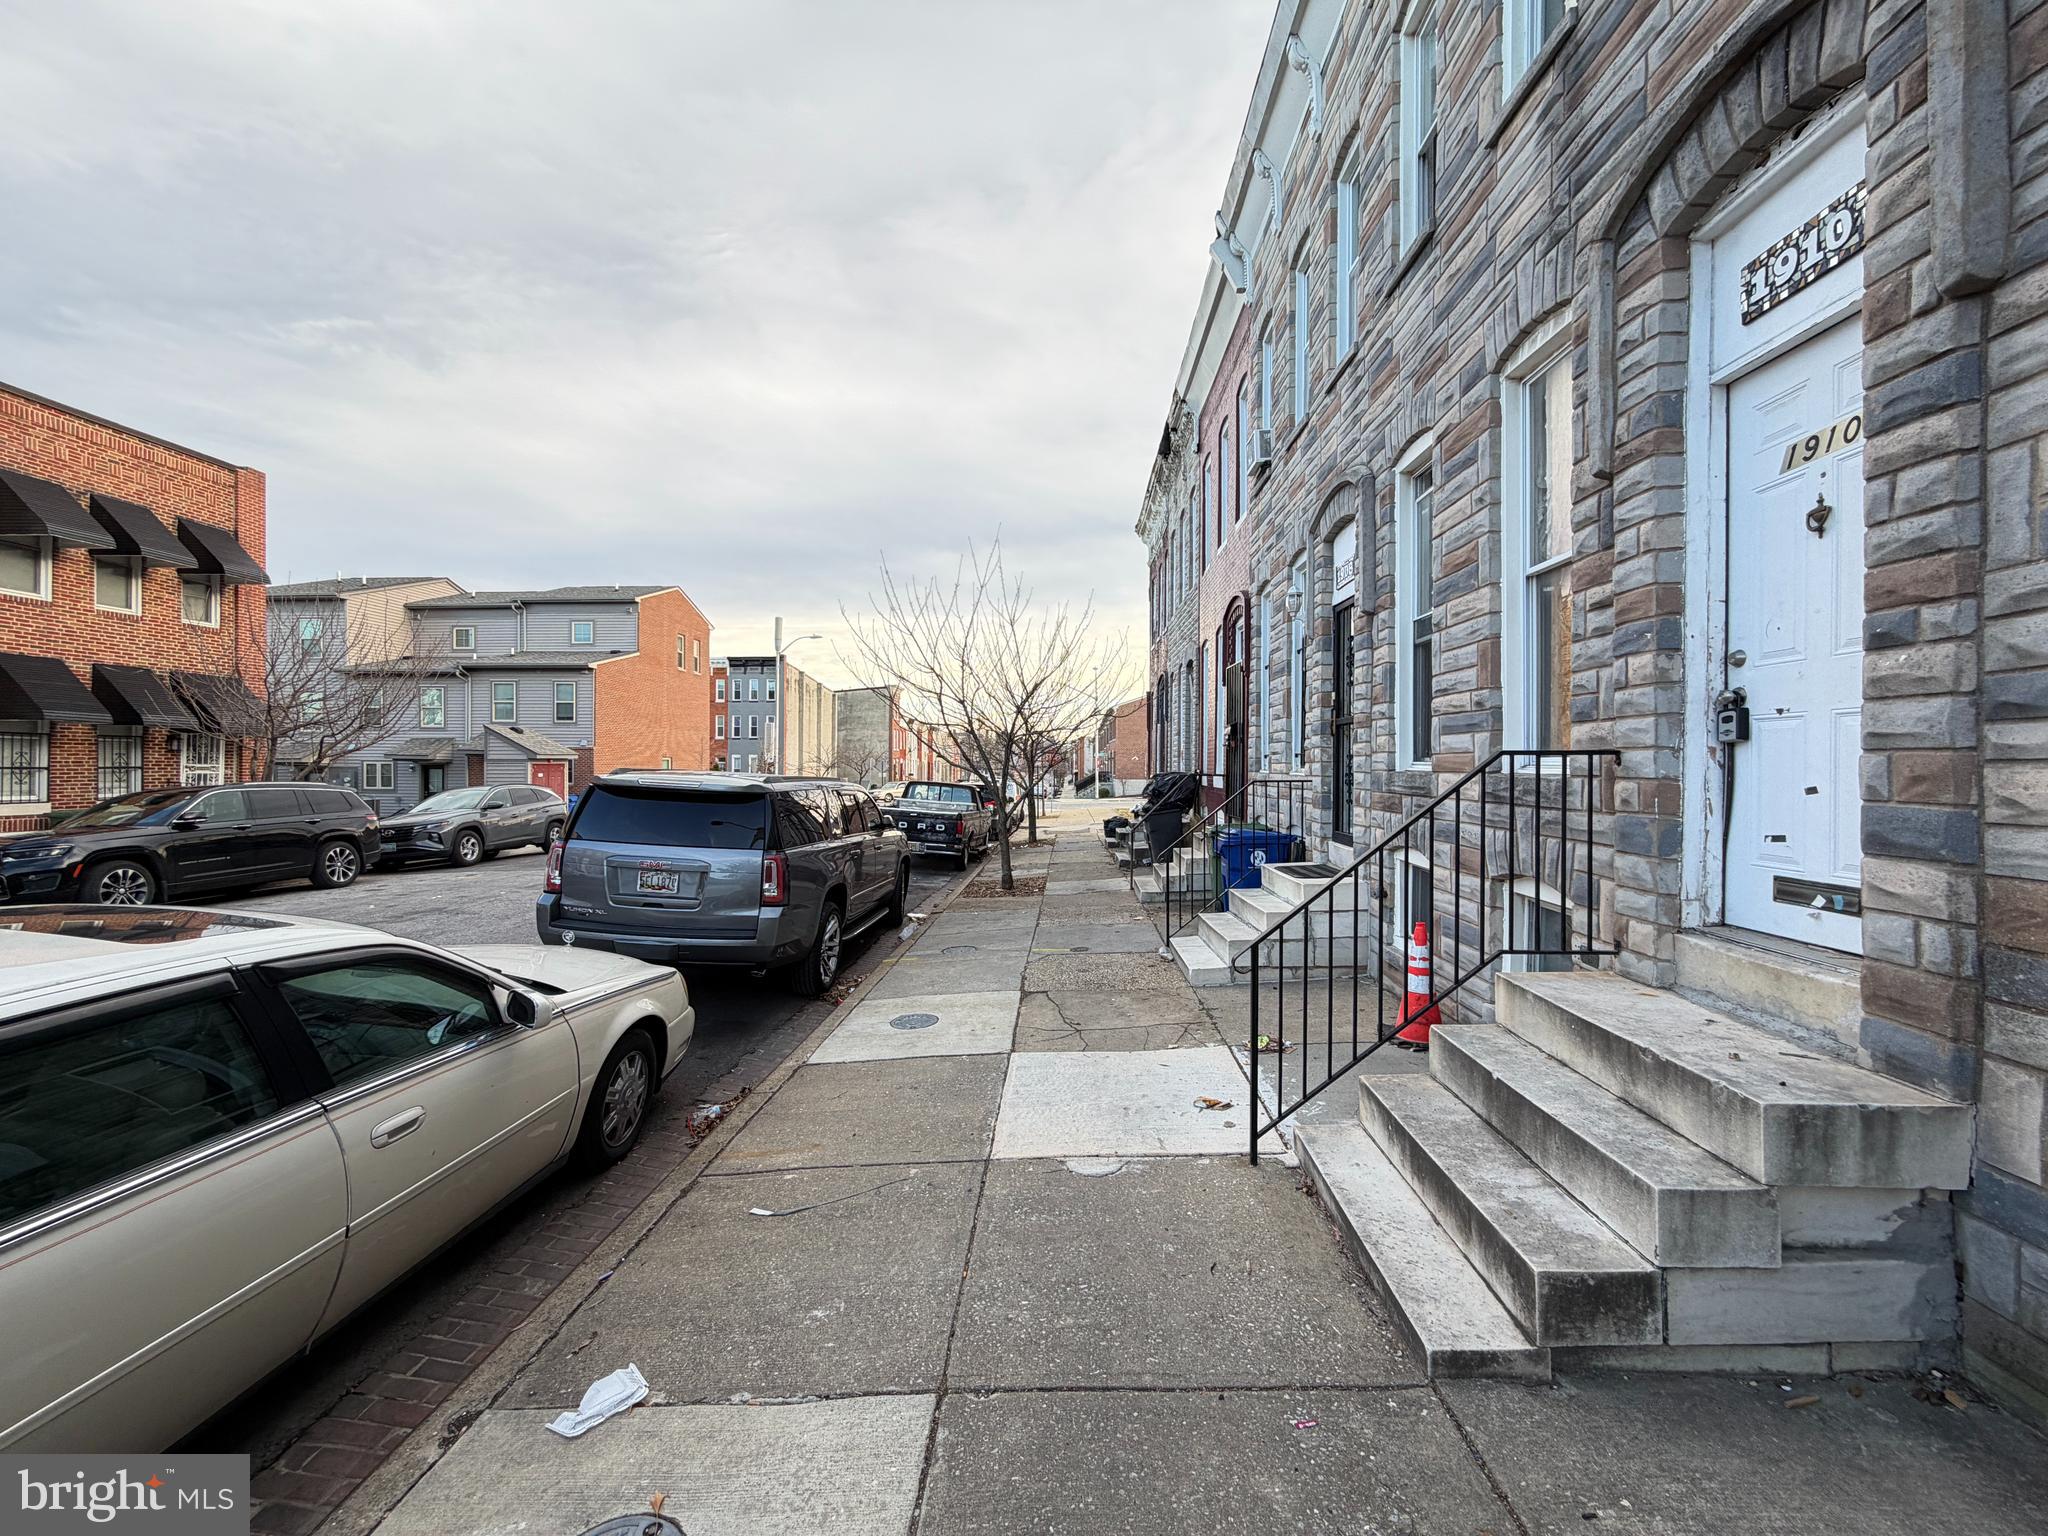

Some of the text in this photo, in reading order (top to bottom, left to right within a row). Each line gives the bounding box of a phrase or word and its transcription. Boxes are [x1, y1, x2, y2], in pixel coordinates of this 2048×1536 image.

[1749, 208, 1853, 304] 1910
[1786, 415, 1862, 470] 1910
[898, 821, 946, 831] ORD
